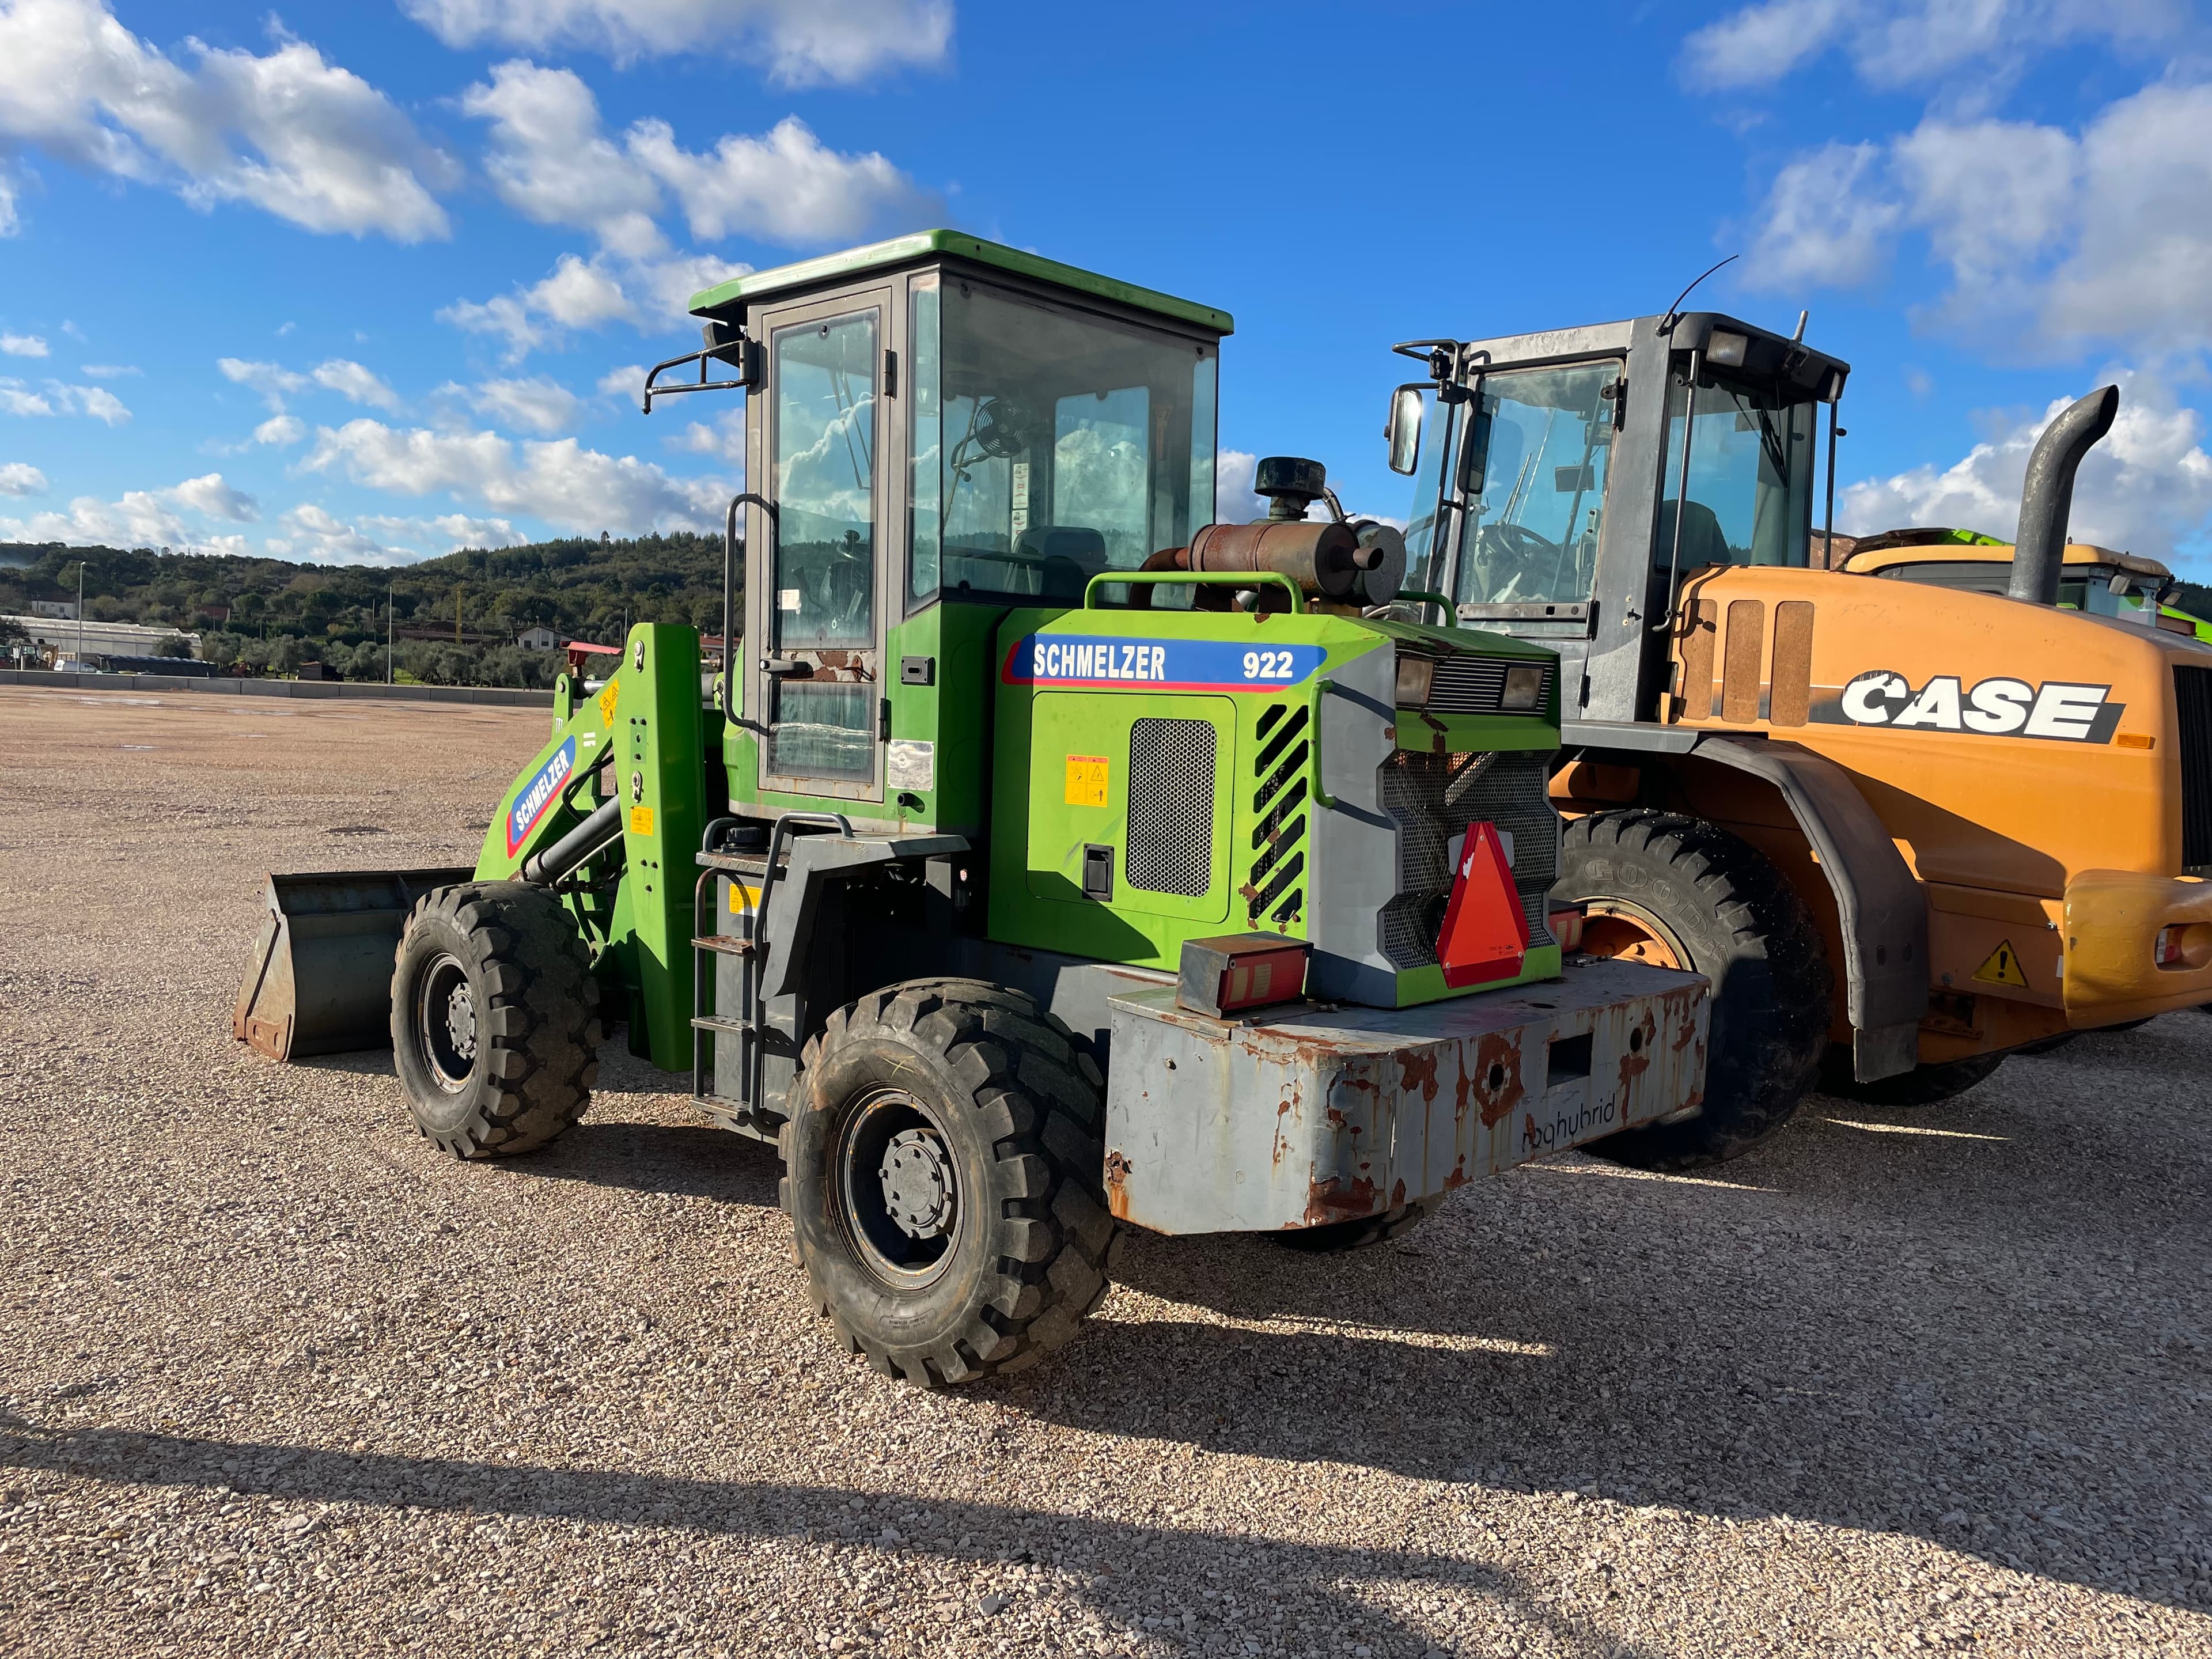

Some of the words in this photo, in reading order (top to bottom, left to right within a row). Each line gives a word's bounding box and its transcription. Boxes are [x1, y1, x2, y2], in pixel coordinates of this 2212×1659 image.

[1033, 643, 1165, 680] SCHMELZER
[1243, 651, 1294, 679] 922
[1841, 671, 2107, 740] CASE
[516, 749, 570, 832] SCHMELZER
